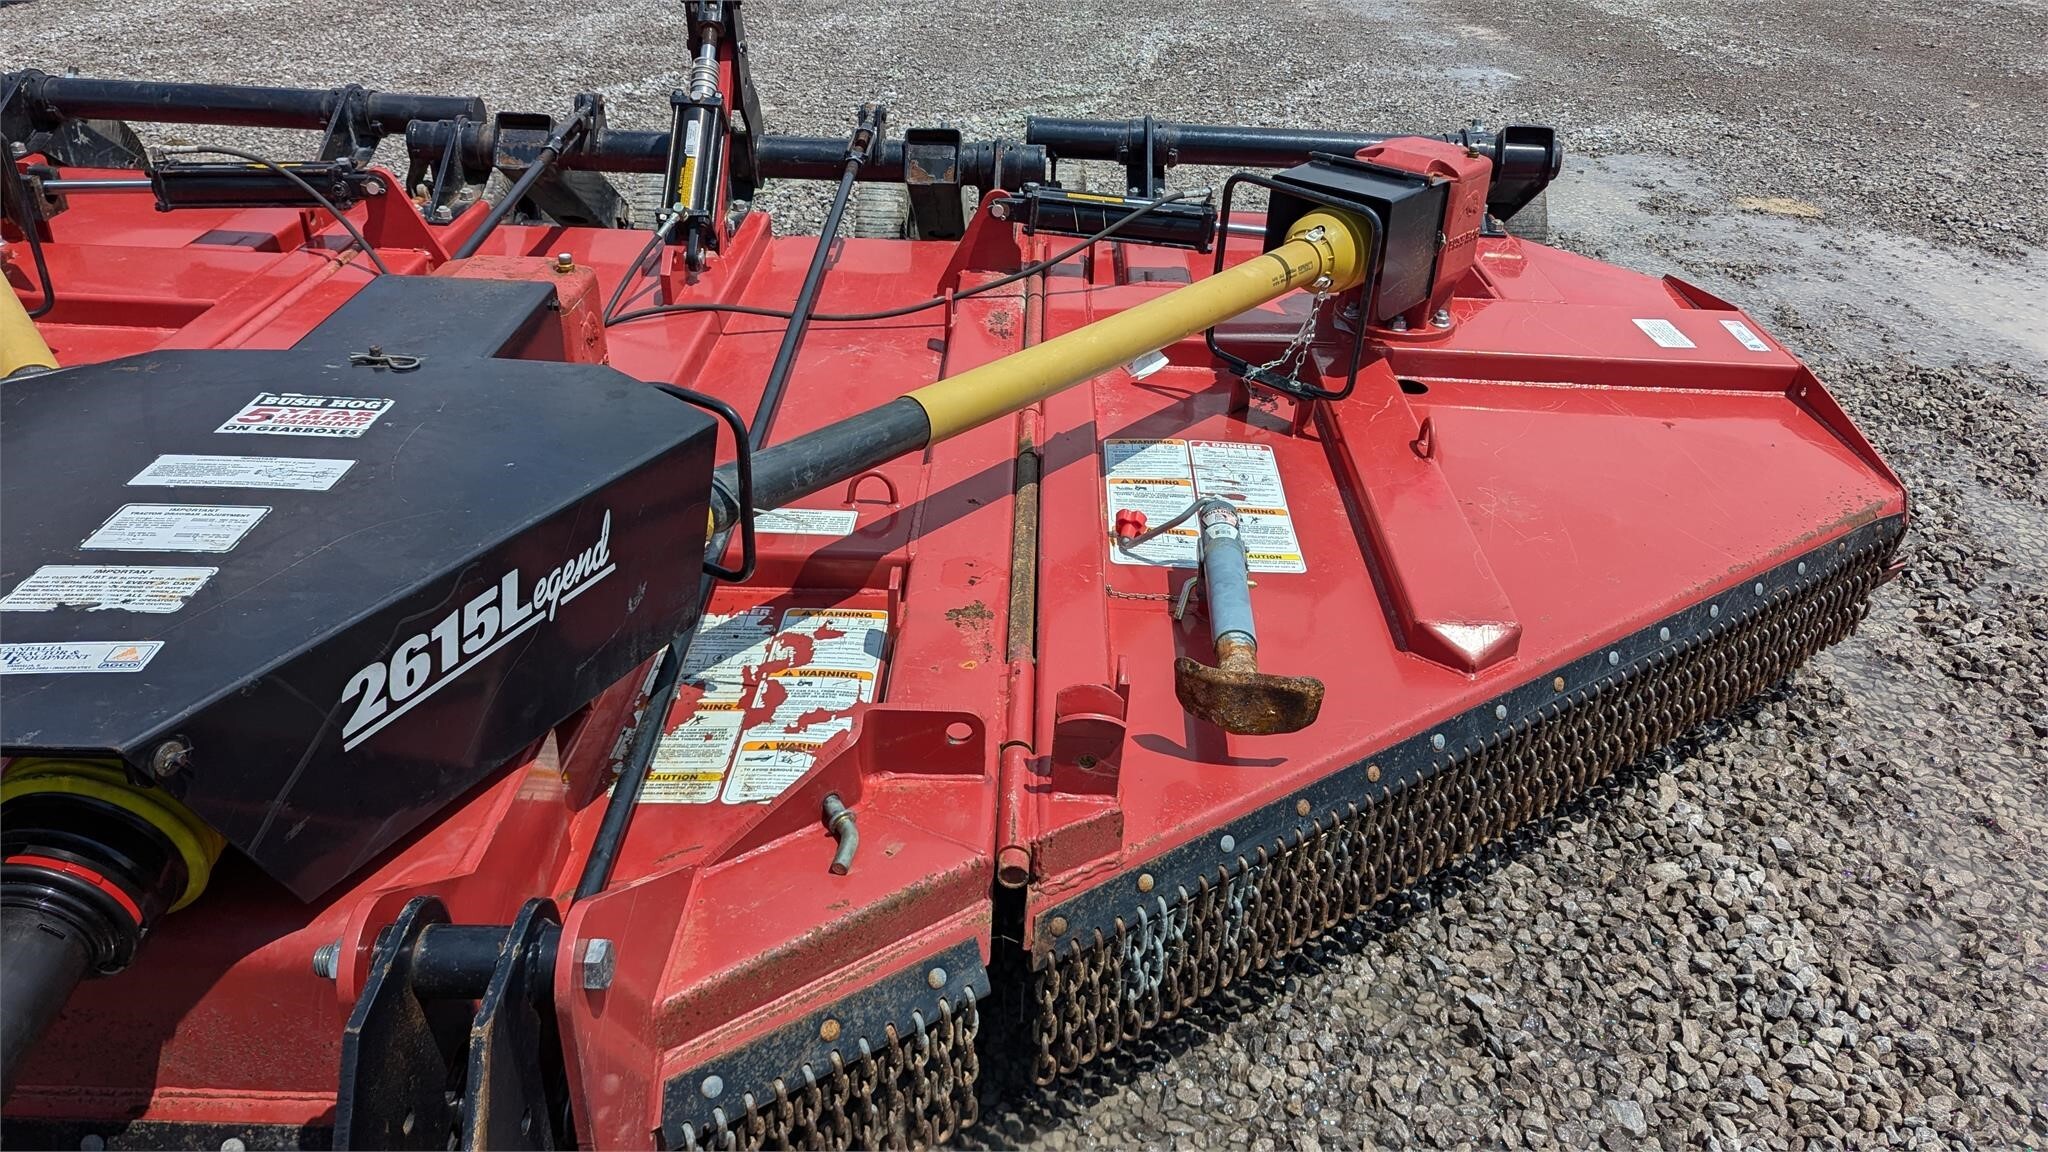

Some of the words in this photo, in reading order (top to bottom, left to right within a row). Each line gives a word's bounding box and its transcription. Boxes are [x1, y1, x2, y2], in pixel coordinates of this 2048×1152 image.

[259, 396, 327, 407] BUSH
[328, 399, 382, 409] HOG
[237, 407, 283, 423] 5
[284, 408, 376, 417] YEAR
[278, 413, 371, 422] LIMITED
[271, 418, 367, 427] WARRANTY
[256, 425, 361, 435] GEARBOXES
[1211, 442, 1263, 450] DANGER
[8, 654, 92, 664] EQUIPMENT
[341, 585, 500, 740] 2615
[799, 670, 858, 679] WARNING
[700, 703, 732, 711] NING
